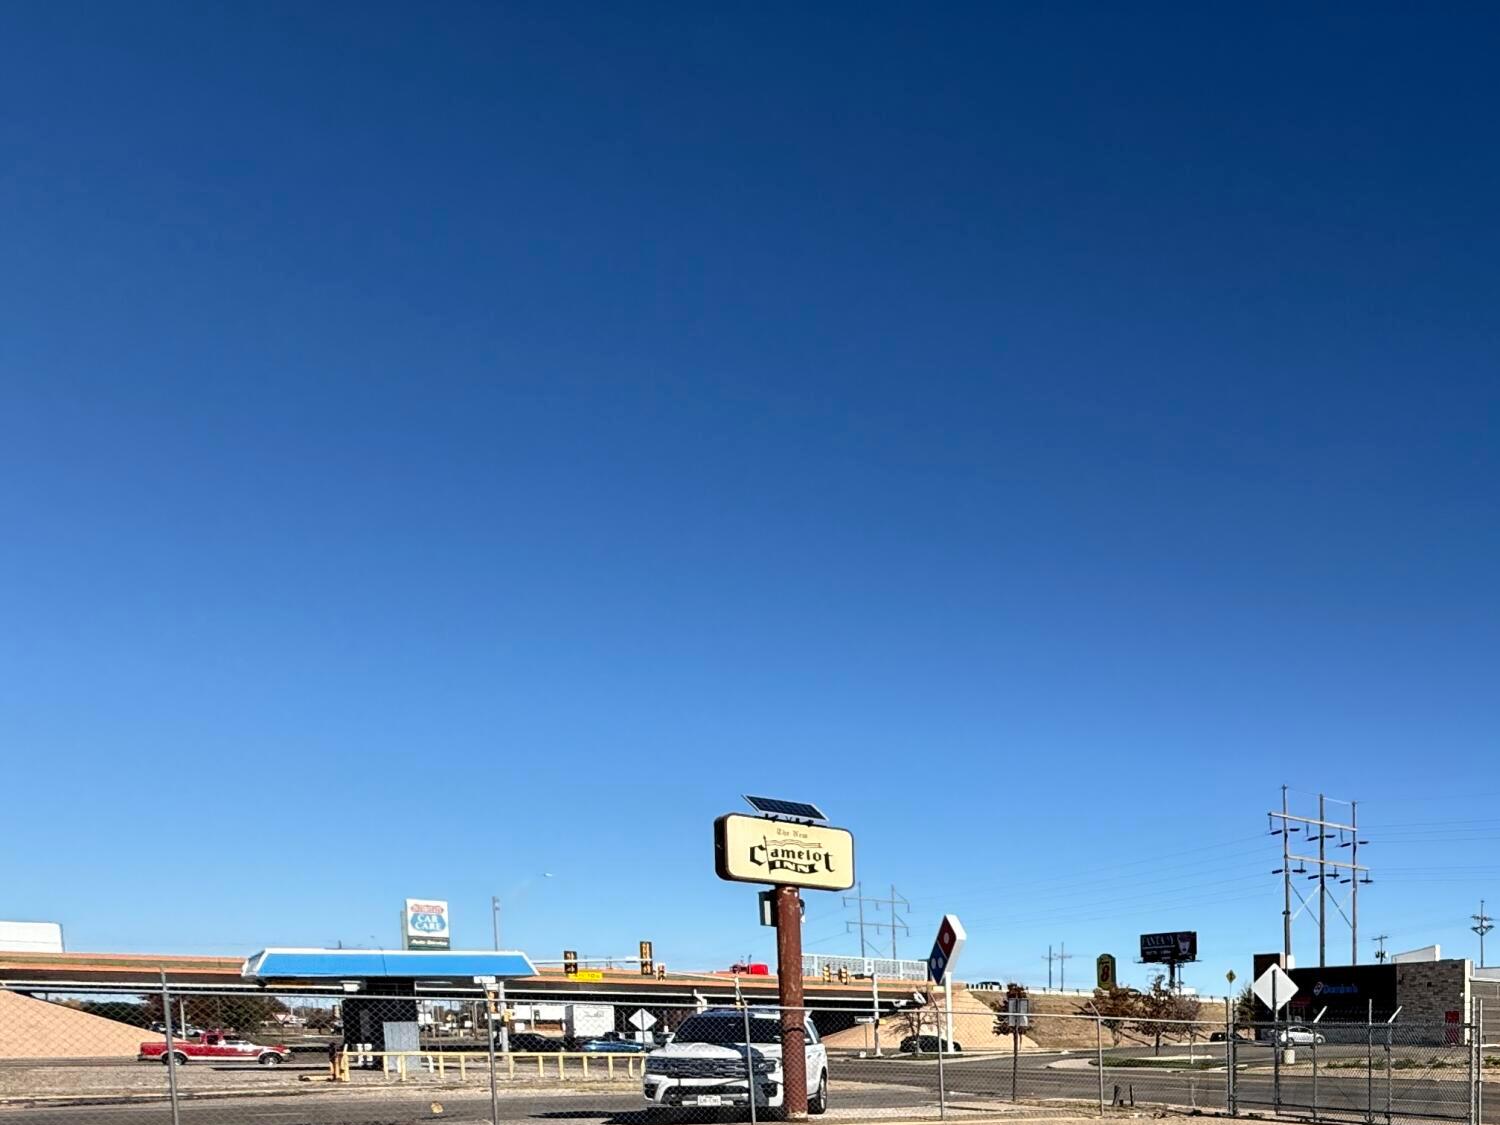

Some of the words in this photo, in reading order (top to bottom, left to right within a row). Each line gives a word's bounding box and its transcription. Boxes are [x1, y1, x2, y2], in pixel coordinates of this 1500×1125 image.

[777, 828, 790, 837] The
[793, 830, 808, 839] New
[750, 845, 835, 873] Camelot
[774, 860, 810, 873] INN
[417, 914, 438, 923] CAR
[415, 922, 441, 931] CARE
